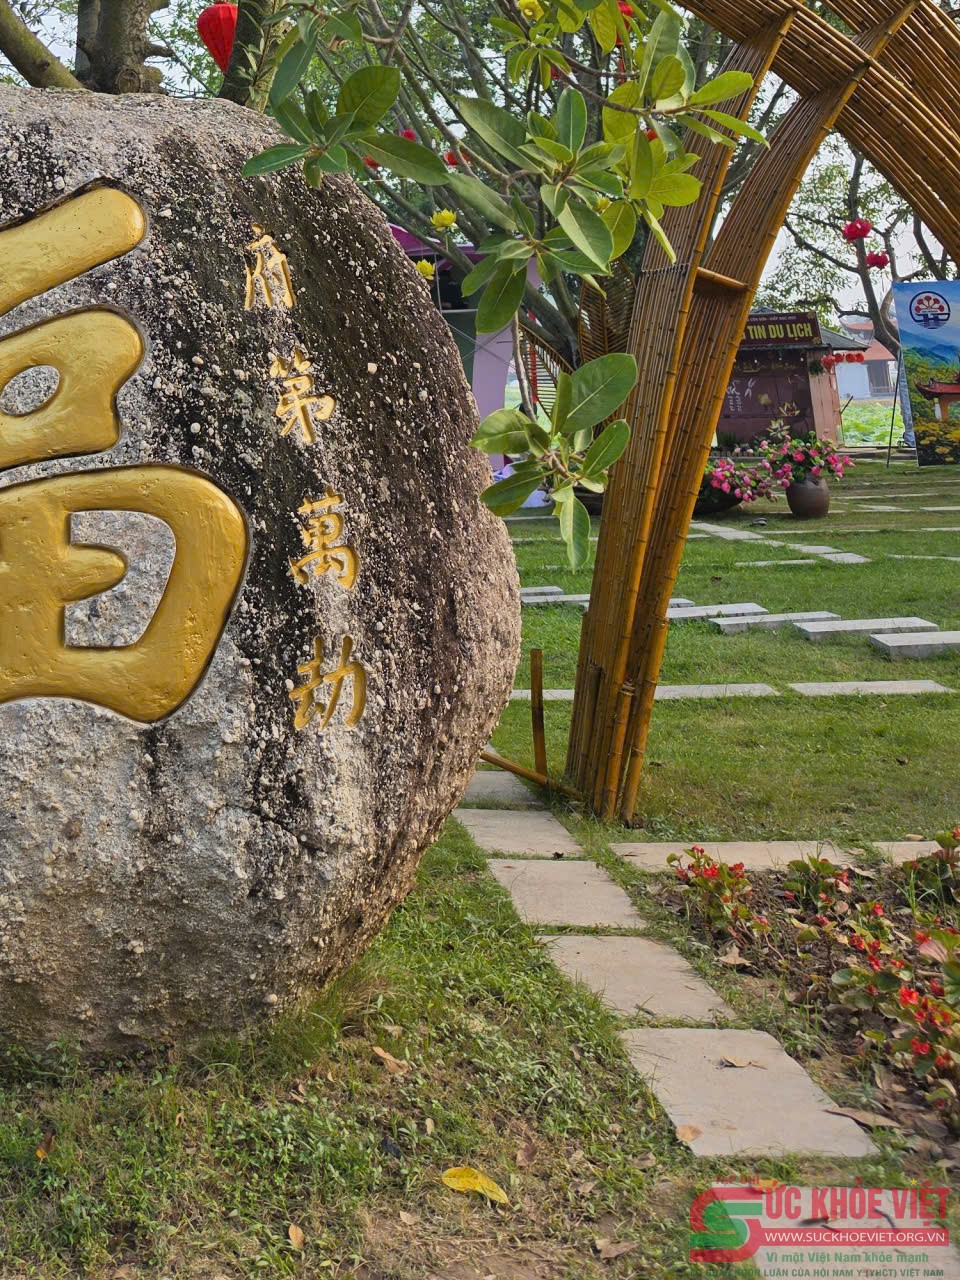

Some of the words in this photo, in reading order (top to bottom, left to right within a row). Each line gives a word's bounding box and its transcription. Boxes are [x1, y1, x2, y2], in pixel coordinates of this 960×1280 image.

[747, 325, 767, 339] TIN
[768, 324, 785, 338] DU
[786, 323, 813, 341] LỊCH
